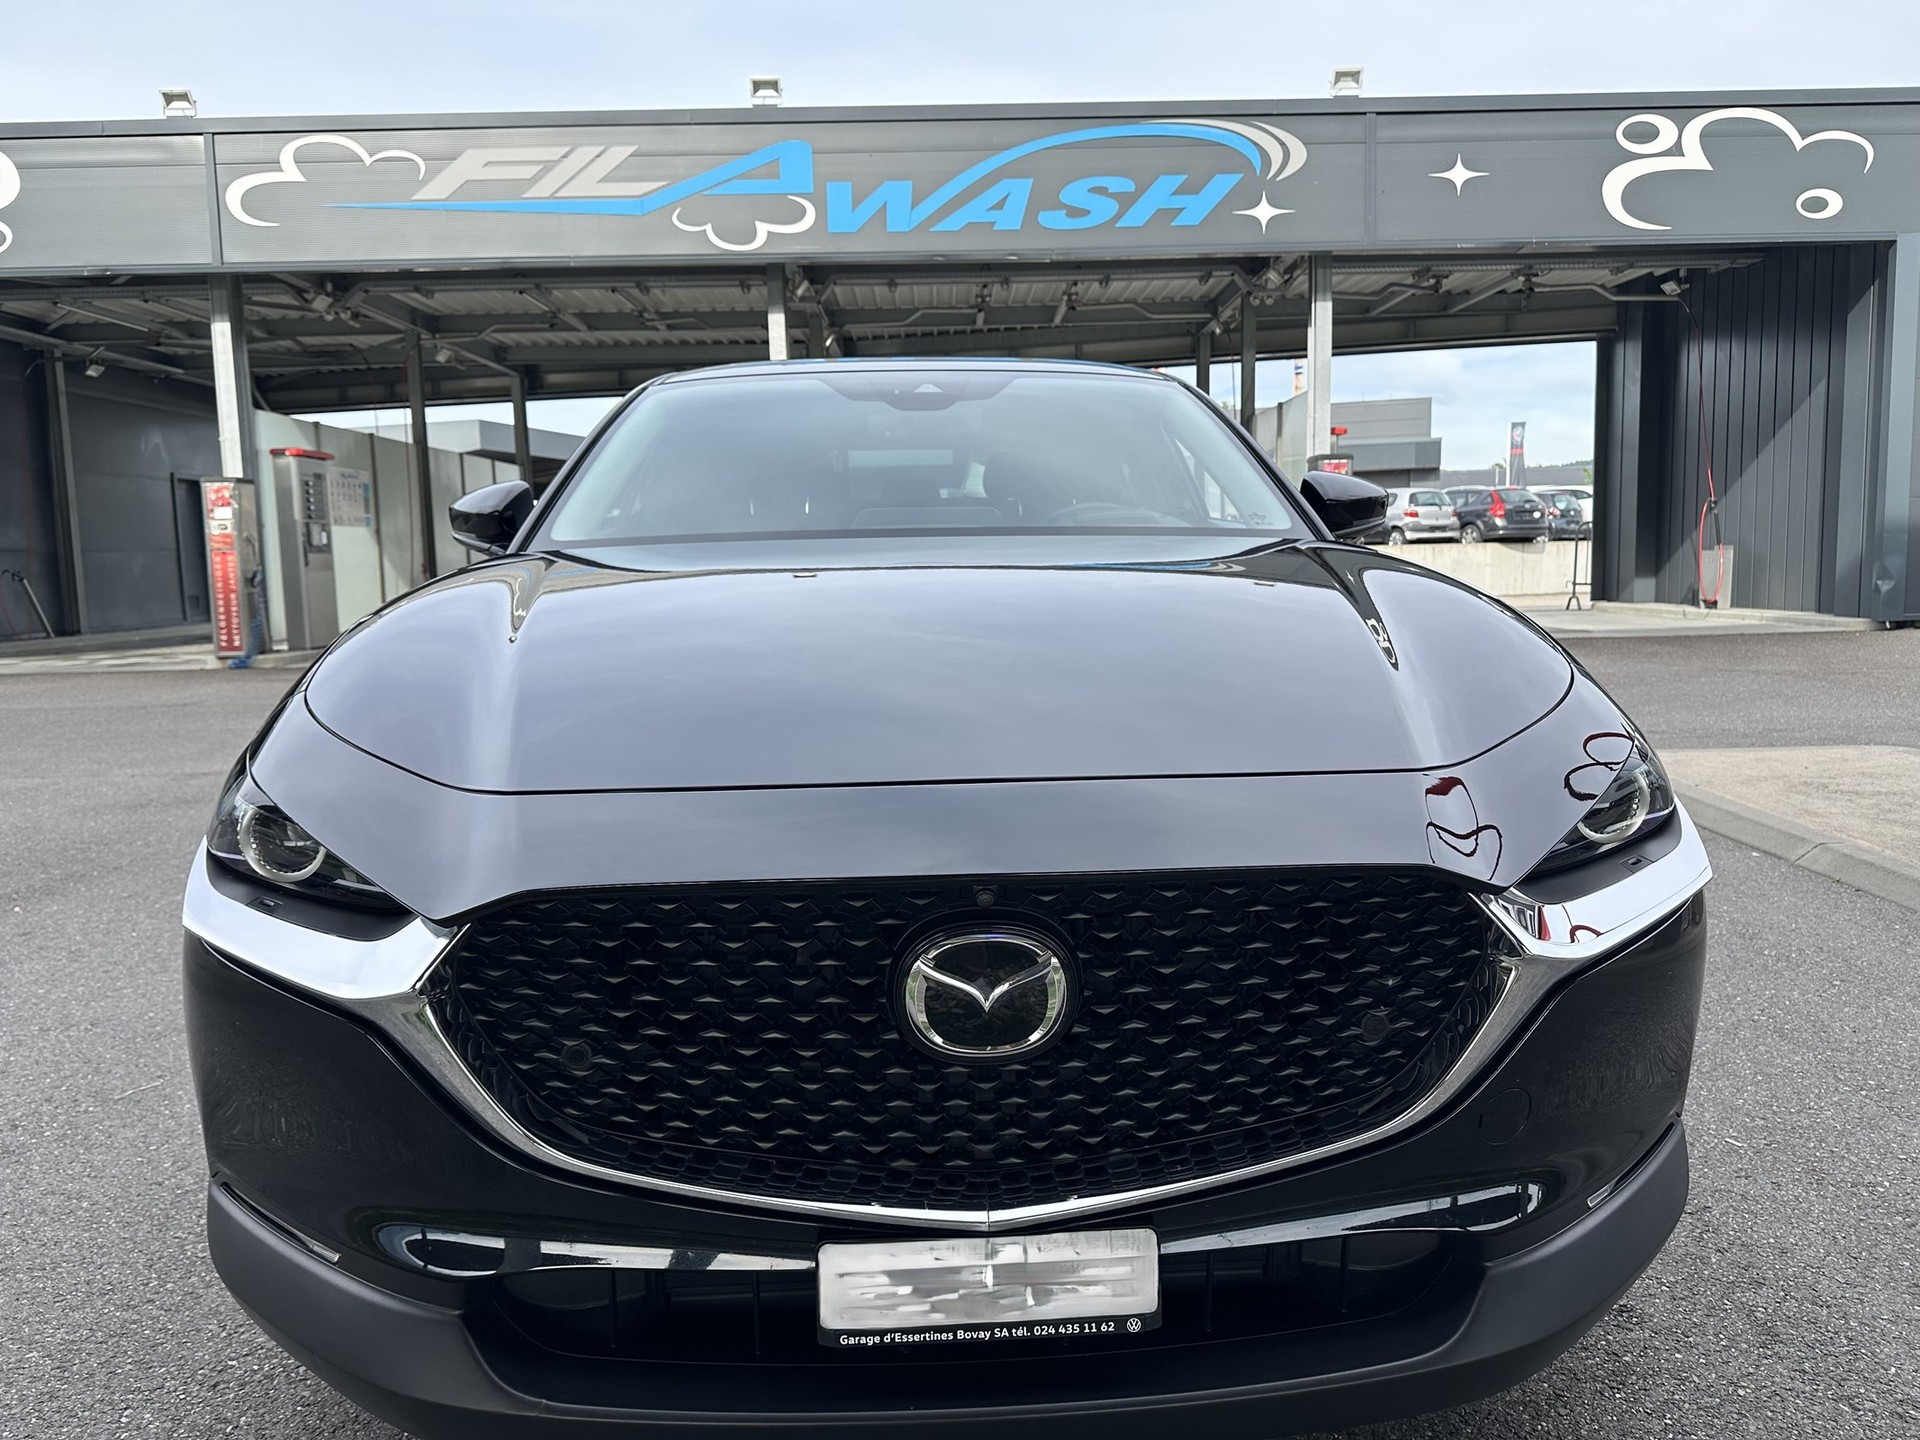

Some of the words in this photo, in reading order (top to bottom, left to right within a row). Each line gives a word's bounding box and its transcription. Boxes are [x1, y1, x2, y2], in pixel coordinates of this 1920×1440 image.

[826, 171, 1245, 233] WASH
[839, 1332, 881, 1346] Garage
[883, 1330, 954, 1343] d'Essertines
[956, 1328, 993, 1341] Bovay
[993, 1327, 1010, 1338] SA
[1011, 1325, 1031, 1337] tél.
[1033, 1324, 1056, 1336] 024
[1058, 1323, 1081, 1335] 435
[1083, 1322, 1099, 1333] 11
[1100, 1321, 1116, 1332] 62
